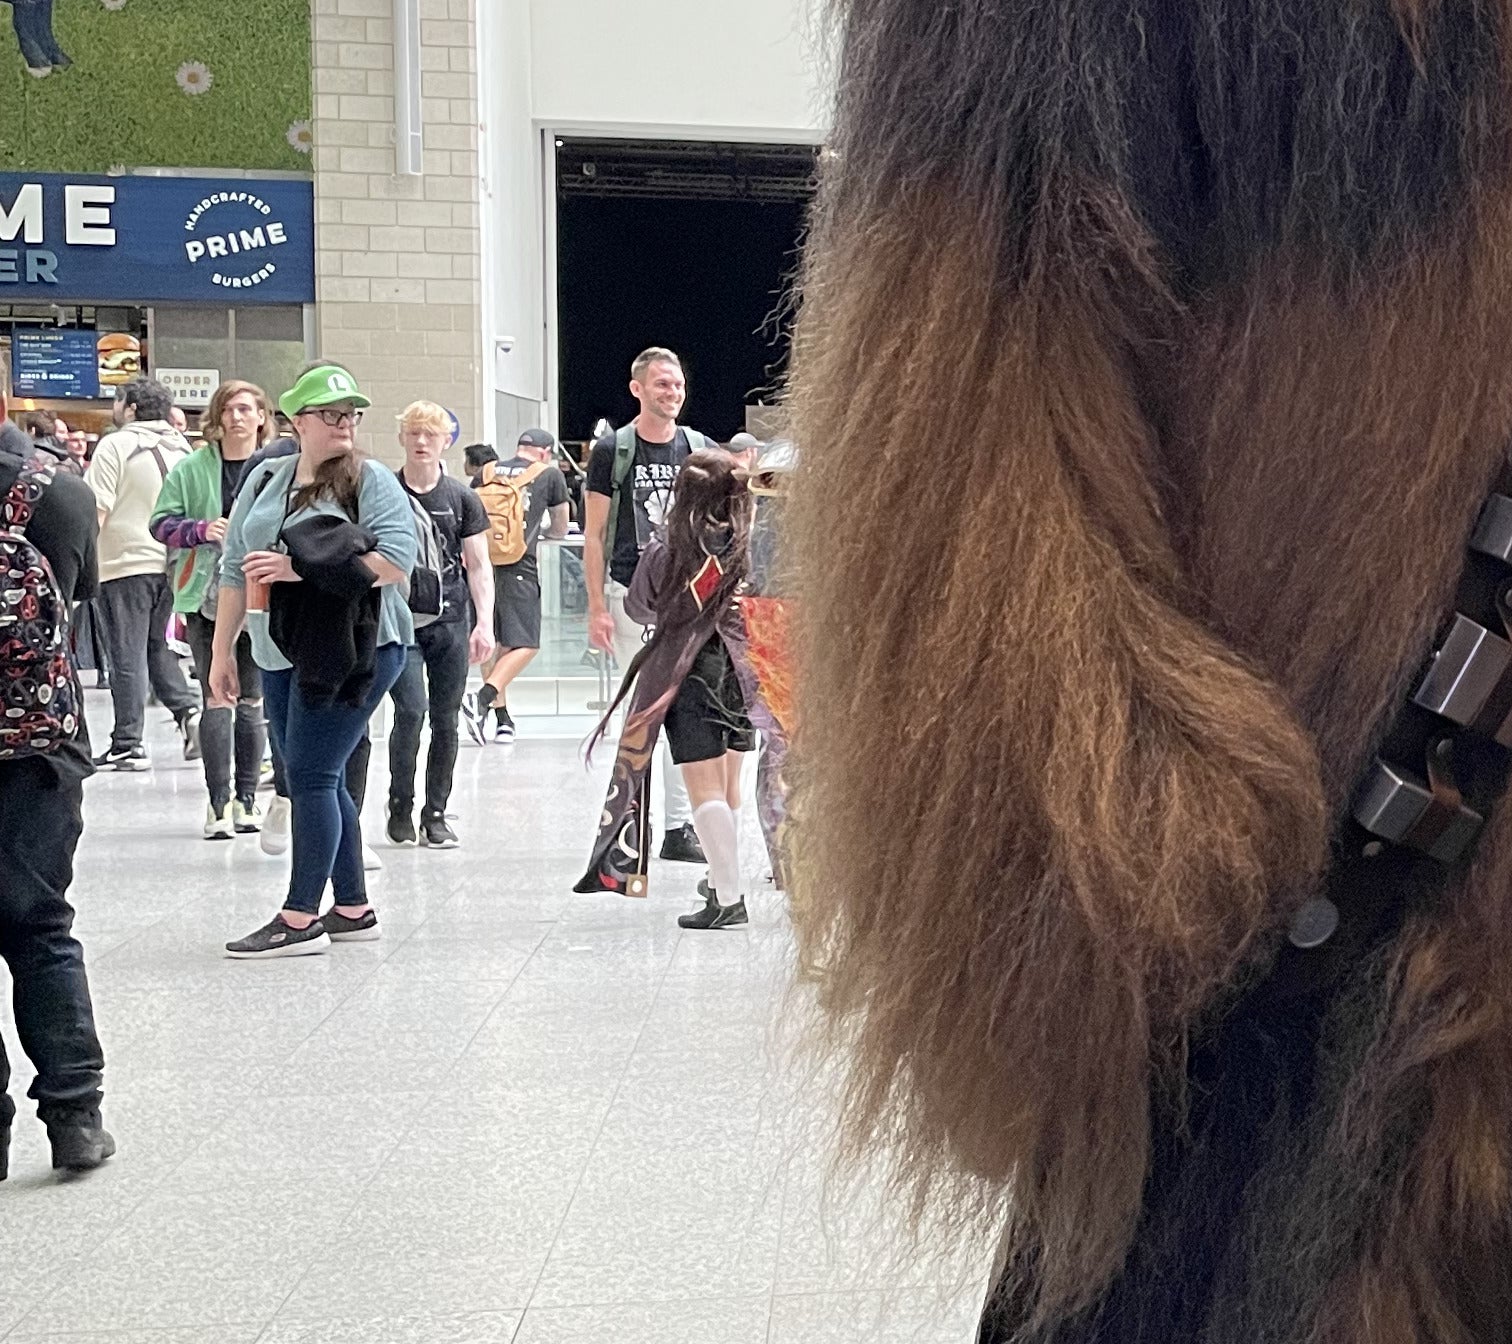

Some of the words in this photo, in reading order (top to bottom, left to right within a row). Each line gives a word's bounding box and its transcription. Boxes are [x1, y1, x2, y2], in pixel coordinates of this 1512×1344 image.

[0, 184, 116, 245] ME
[184, 192, 271, 231] HANDCRAFTED
[185, 222, 287, 262] PRIME
[0, 249, 58, 283] ER
[211, 263, 276, 288] BURGERS
[162, 375, 211, 385] ORDER
[333, 377, 346, 391] L
